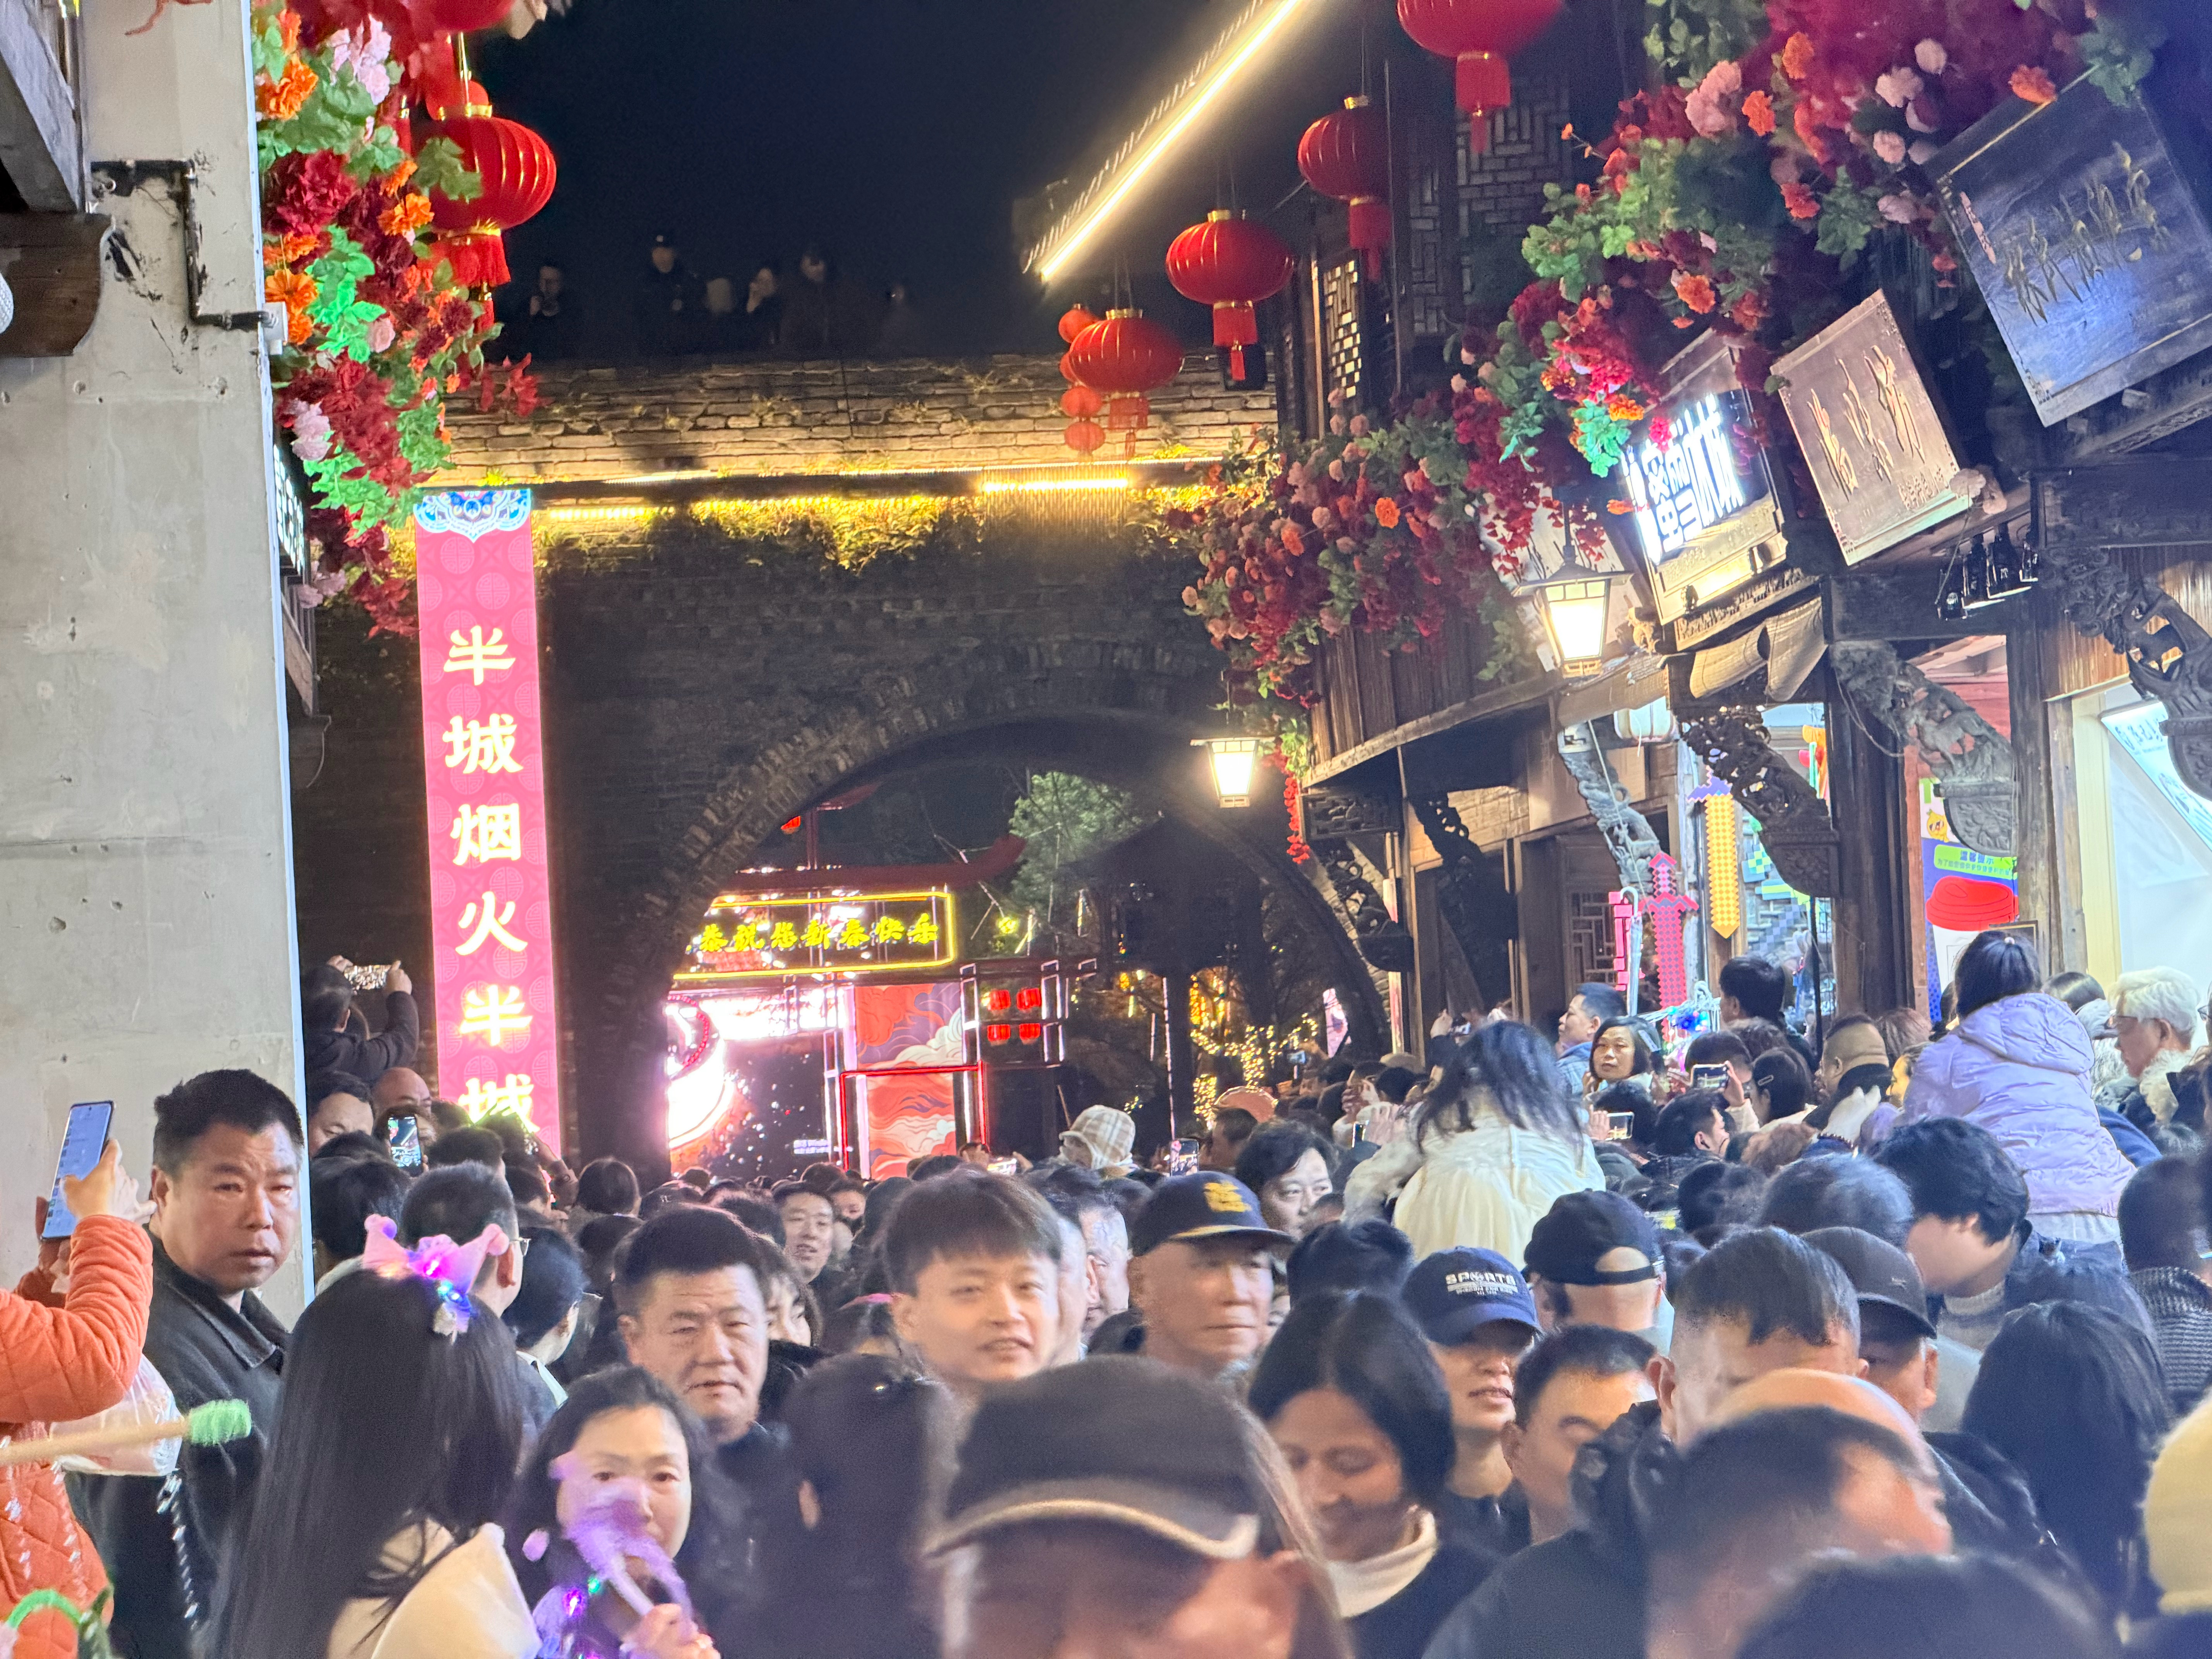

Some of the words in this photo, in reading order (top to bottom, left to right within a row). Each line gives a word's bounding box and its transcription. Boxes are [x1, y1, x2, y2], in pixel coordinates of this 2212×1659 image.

[1641, 392, 1744, 552] 蜜雪冰城
[443, 624, 541, 1133] 半城烟火半城
[699, 912, 939, 952] 恭祝您新春快乐
